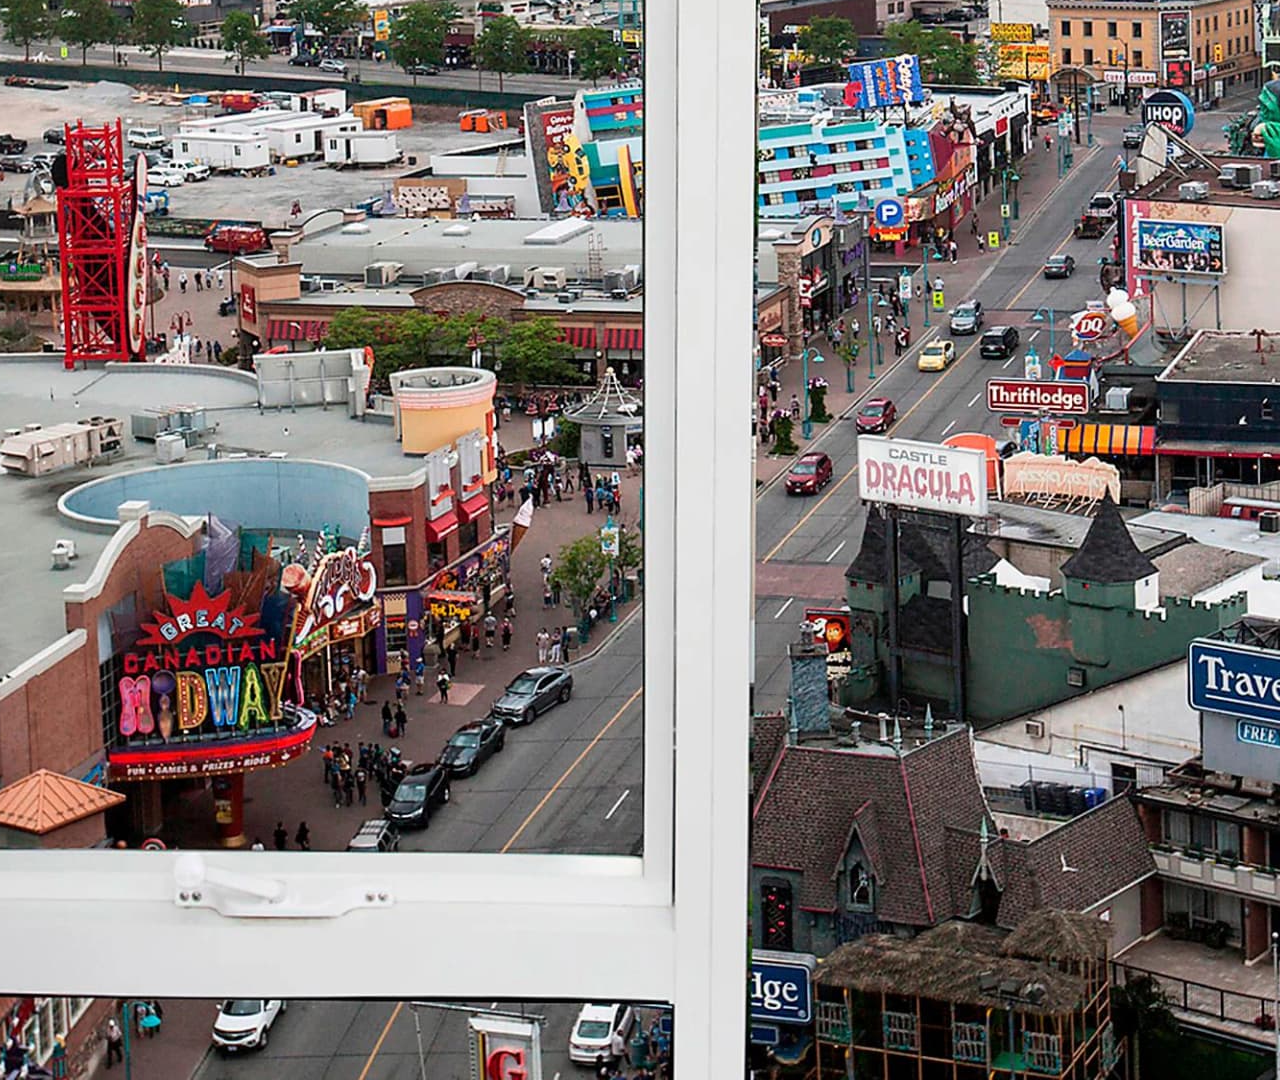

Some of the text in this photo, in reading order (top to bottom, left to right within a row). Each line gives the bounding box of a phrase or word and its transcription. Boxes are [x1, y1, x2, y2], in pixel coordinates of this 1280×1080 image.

[1129, 74, 1155, 83] CIGARS
[1147, 106, 1182, 124] IHOP
[881, 205, 898, 222] P
[1080, 317, 1103, 333] DQ
[989, 385, 1084, 410] Thriftlodge
[888, 448, 948, 466] CASTLE
[865, 458, 976, 504] DRACULA
[430, 603, 471, 621] Hot Dogs
[160, 609, 244, 641] GREAT
[123, 638, 276, 673] CANADIAN
[1242, 724, 1277, 744] FREE
[127, 767, 146, 776] FUN
[155, 765, 188, 774] GAMES
[202, 760, 235, 771] PRIZES
[243, 755, 271, 767] RIDES
